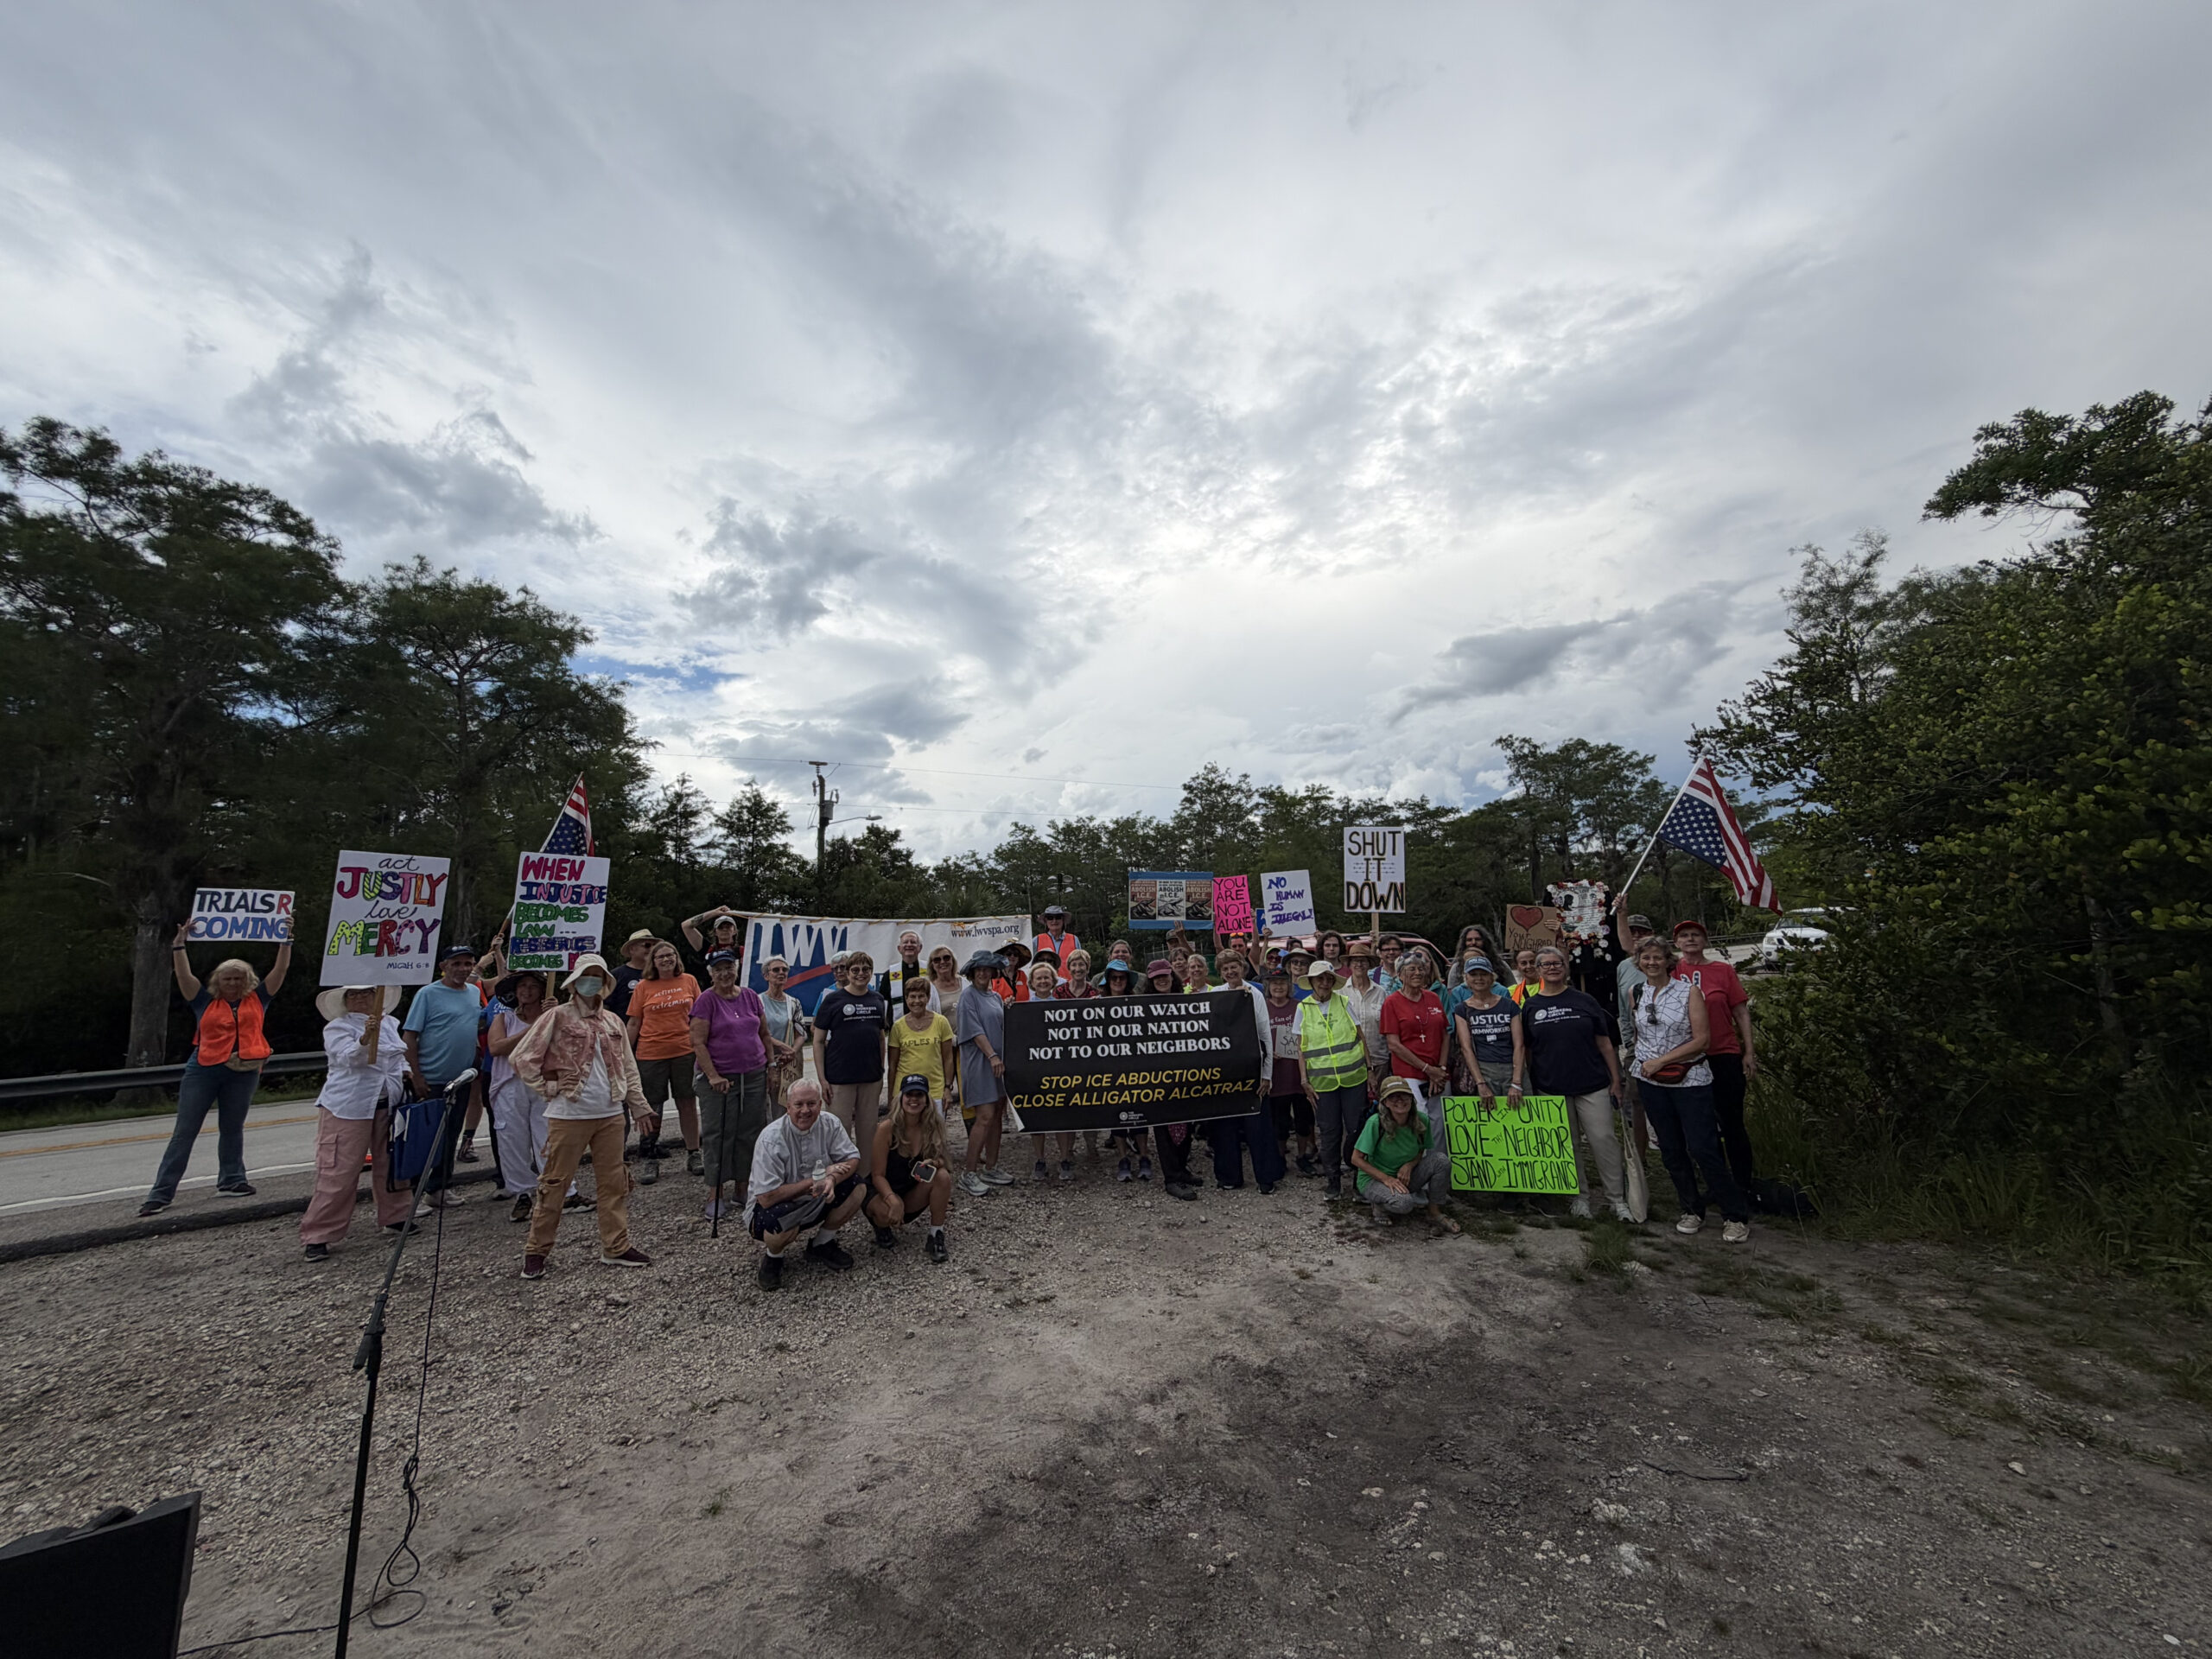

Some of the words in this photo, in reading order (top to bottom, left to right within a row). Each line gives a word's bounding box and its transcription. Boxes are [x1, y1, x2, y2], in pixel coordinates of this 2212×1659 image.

[1348, 831, 1402, 856] SHUT
[378, 856, 420, 872] act
[521, 855, 586, 881] WHEN
[1363, 858, 1386, 881] IT
[337, 867, 448, 907] JUSTLY
[519, 881, 607, 906] INJUSTICE
[1213, 877, 1246, 891] YOU
[1267, 877, 1287, 890] NO
[1275, 889, 1305, 901] HUMAN
[196, 891, 275, 914] TRIALS
[1216, 889, 1245, 902] ARE
[1268, 902, 1284, 912] IS
[1346, 881, 1404, 911] DOWN
[365, 900, 417, 919] love
[513, 901, 589, 924] BECOMES
[1217, 902, 1249, 918] NOT
[189, 916, 289, 940] COMING
[515, 924, 556, 938] LAW
[951, 925, 1020, 938] www.lwvspa.org
[1217, 916, 1252, 931] ALONE
[327, 918, 441, 957] MERCY
[508, 954, 563, 969] BECOMES
[1044, 1008, 1077, 1022] NOT
[1082, 1007, 1105, 1020] ON
[1109, 1005, 1145, 1019] OUR
[1149, 1001, 1211, 1016] WATCH
[1047, 1027, 1081, 1040] NOT
[1086, 1026, 1103, 1039] IN
[1108, 1023, 1143, 1037] OUR
[1147, 1020, 1210, 1035] NATION
[1028, 1046, 1063, 1060] NOT
[1068, 1046, 1092, 1058] TO
[1096, 1043, 1132, 1057] OUR
[1136, 1037, 1231, 1055] NEIGHBORS
[1039, 1075, 1082, 1090] STOP
[1086, 1073, 1113, 1088] ICE
[1116, 1067, 1222, 1086] ABDUCTIONS
[1012, 1093, 1066, 1109] CLOSE
[1069, 1089, 1165, 1107] ALLIGATOR
[1168, 1079, 1255, 1100] ALCATRAZ
[1442, 1097, 1500, 1122] POWER
[1517, 1098, 1565, 1123] UNITY
[1446, 1123, 1493, 1157] LOVE
[1491, 1133, 1504, 1144] THY
[1503, 1124, 1573, 1160] NEIGHBOR
[1450, 1156, 1497, 1189] STAND
[1498, 1158, 1578, 1190] IMMIGRANTS
